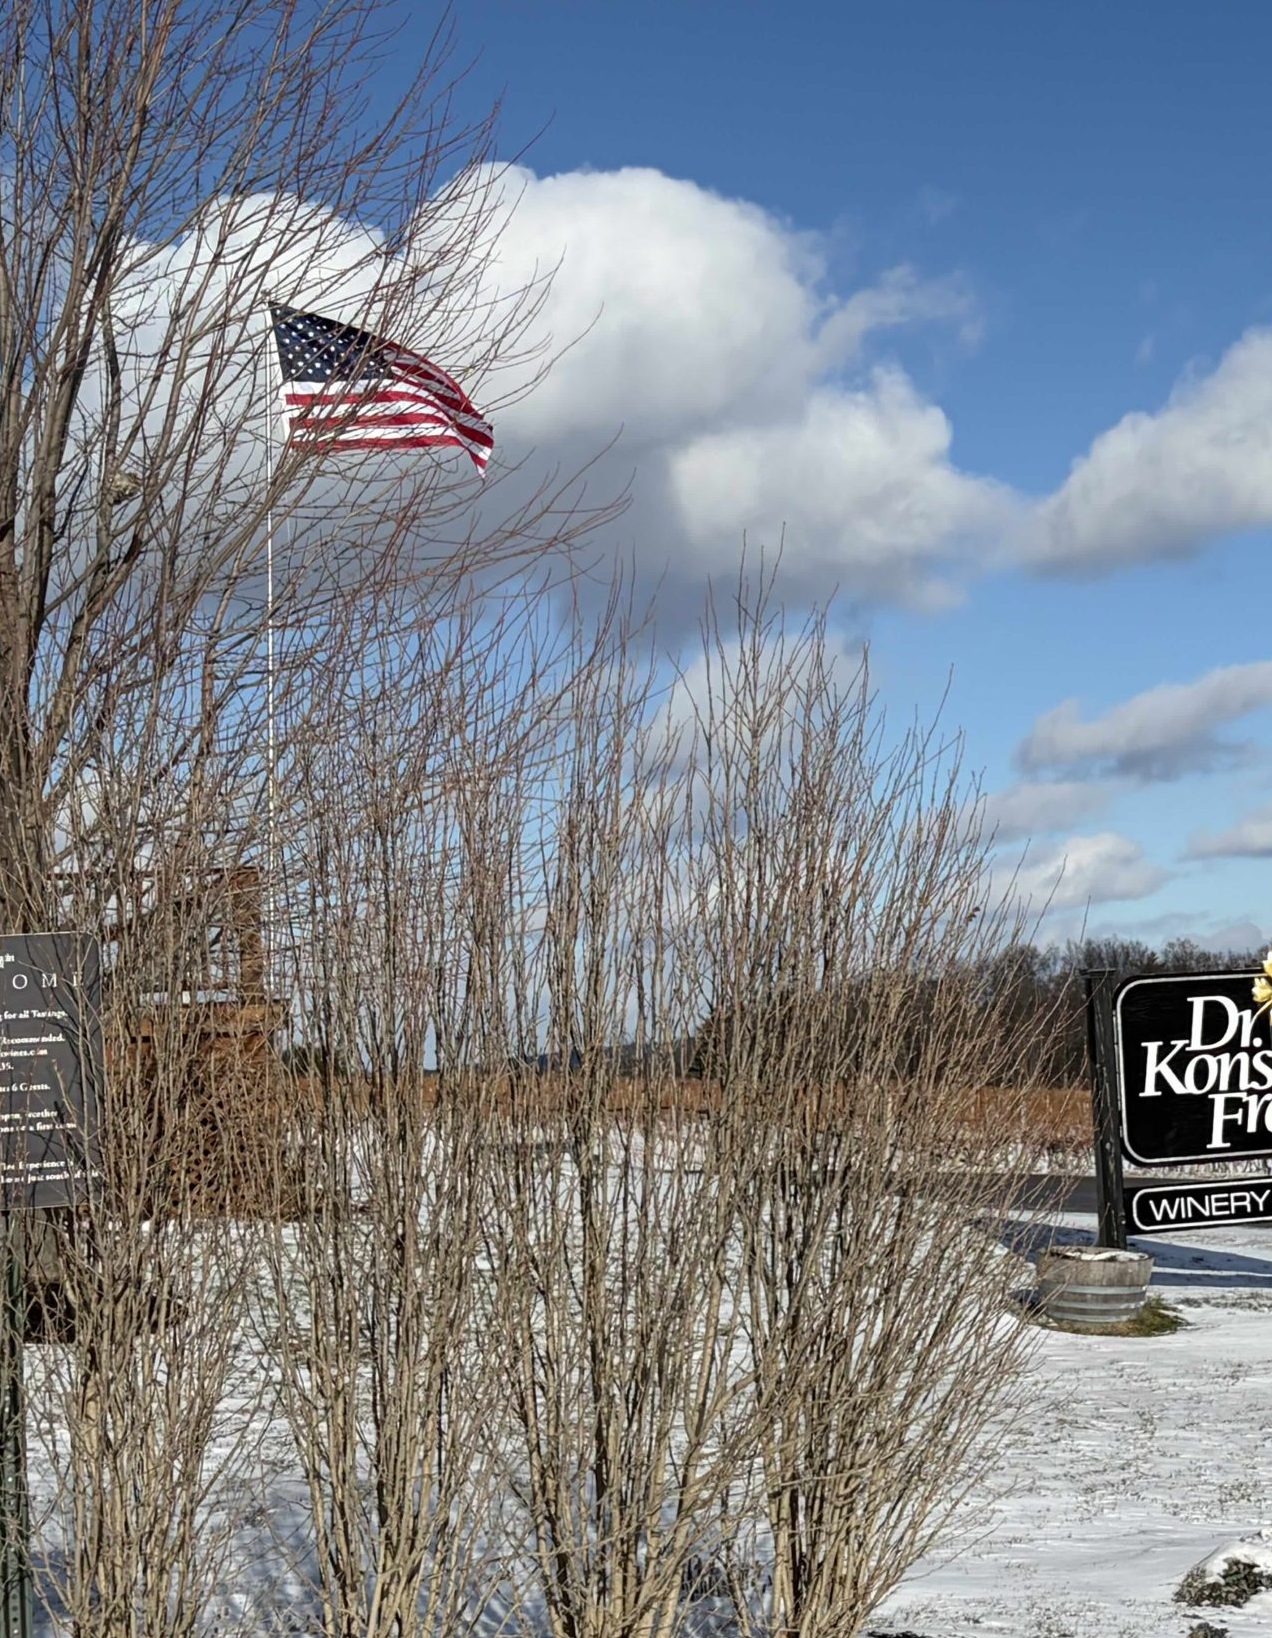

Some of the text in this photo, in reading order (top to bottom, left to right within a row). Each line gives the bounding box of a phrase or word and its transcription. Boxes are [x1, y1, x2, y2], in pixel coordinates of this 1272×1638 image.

[4, 1010, 17, 1019] for
[18, 1009, 30, 1018] all
[1186, 995, 1263, 1052] Dr.
[11, 1082, 18, 1092] 6
[19, 1082, 51, 1092] Gests.
[19, 1160, 65, 1171] Eperience
[1149, 1189, 1272, 1222] WINERY
